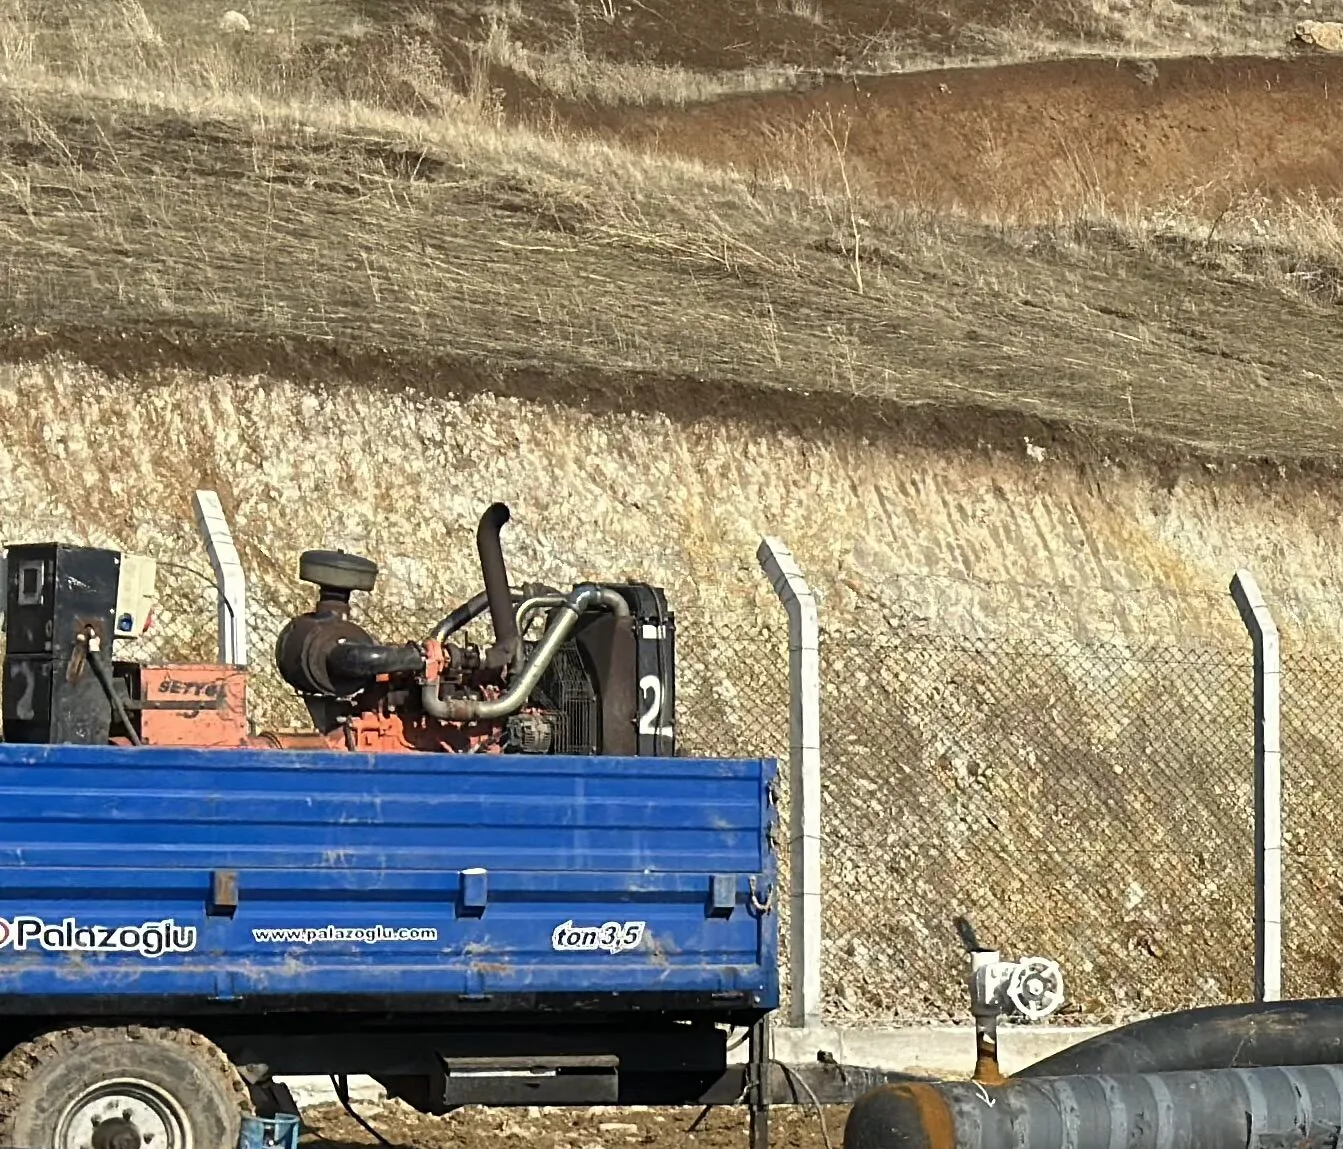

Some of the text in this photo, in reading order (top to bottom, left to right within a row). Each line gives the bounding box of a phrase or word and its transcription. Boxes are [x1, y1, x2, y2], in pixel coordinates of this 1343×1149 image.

[639, 674, 673, 737] 2
[16, 917, 196, 956] Palazoğlu
[253, 925, 437, 944] www.palazoglu.com
[555, 923, 598, 948] ton
